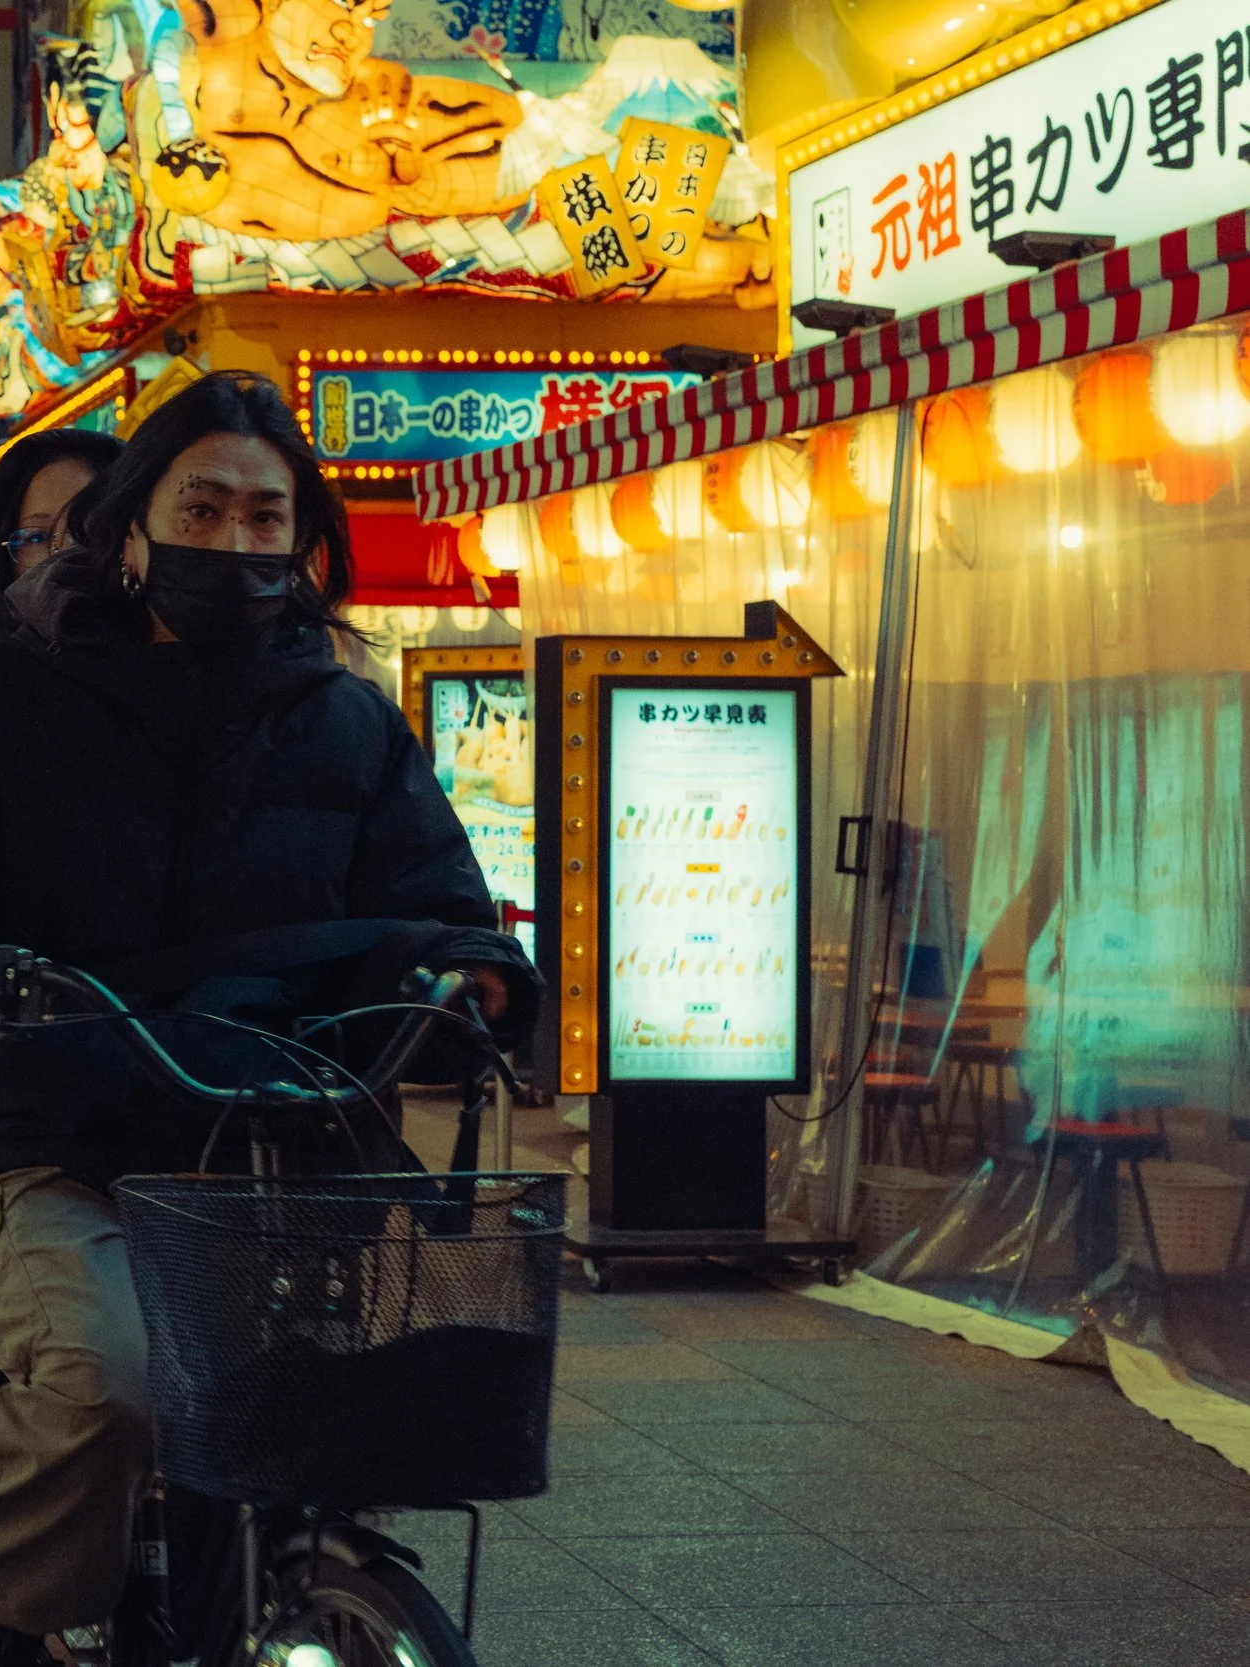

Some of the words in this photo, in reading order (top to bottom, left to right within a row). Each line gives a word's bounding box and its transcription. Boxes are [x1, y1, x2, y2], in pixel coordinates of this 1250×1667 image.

[560, 171, 630, 282] 横綱
[624, 133, 668, 241] 串かつ
[661, 143, 708, 256] 日本一の
[351, 391, 535, 443] 日本一の串かつ
[638, 702, 768, 726] 串カツ早見表
